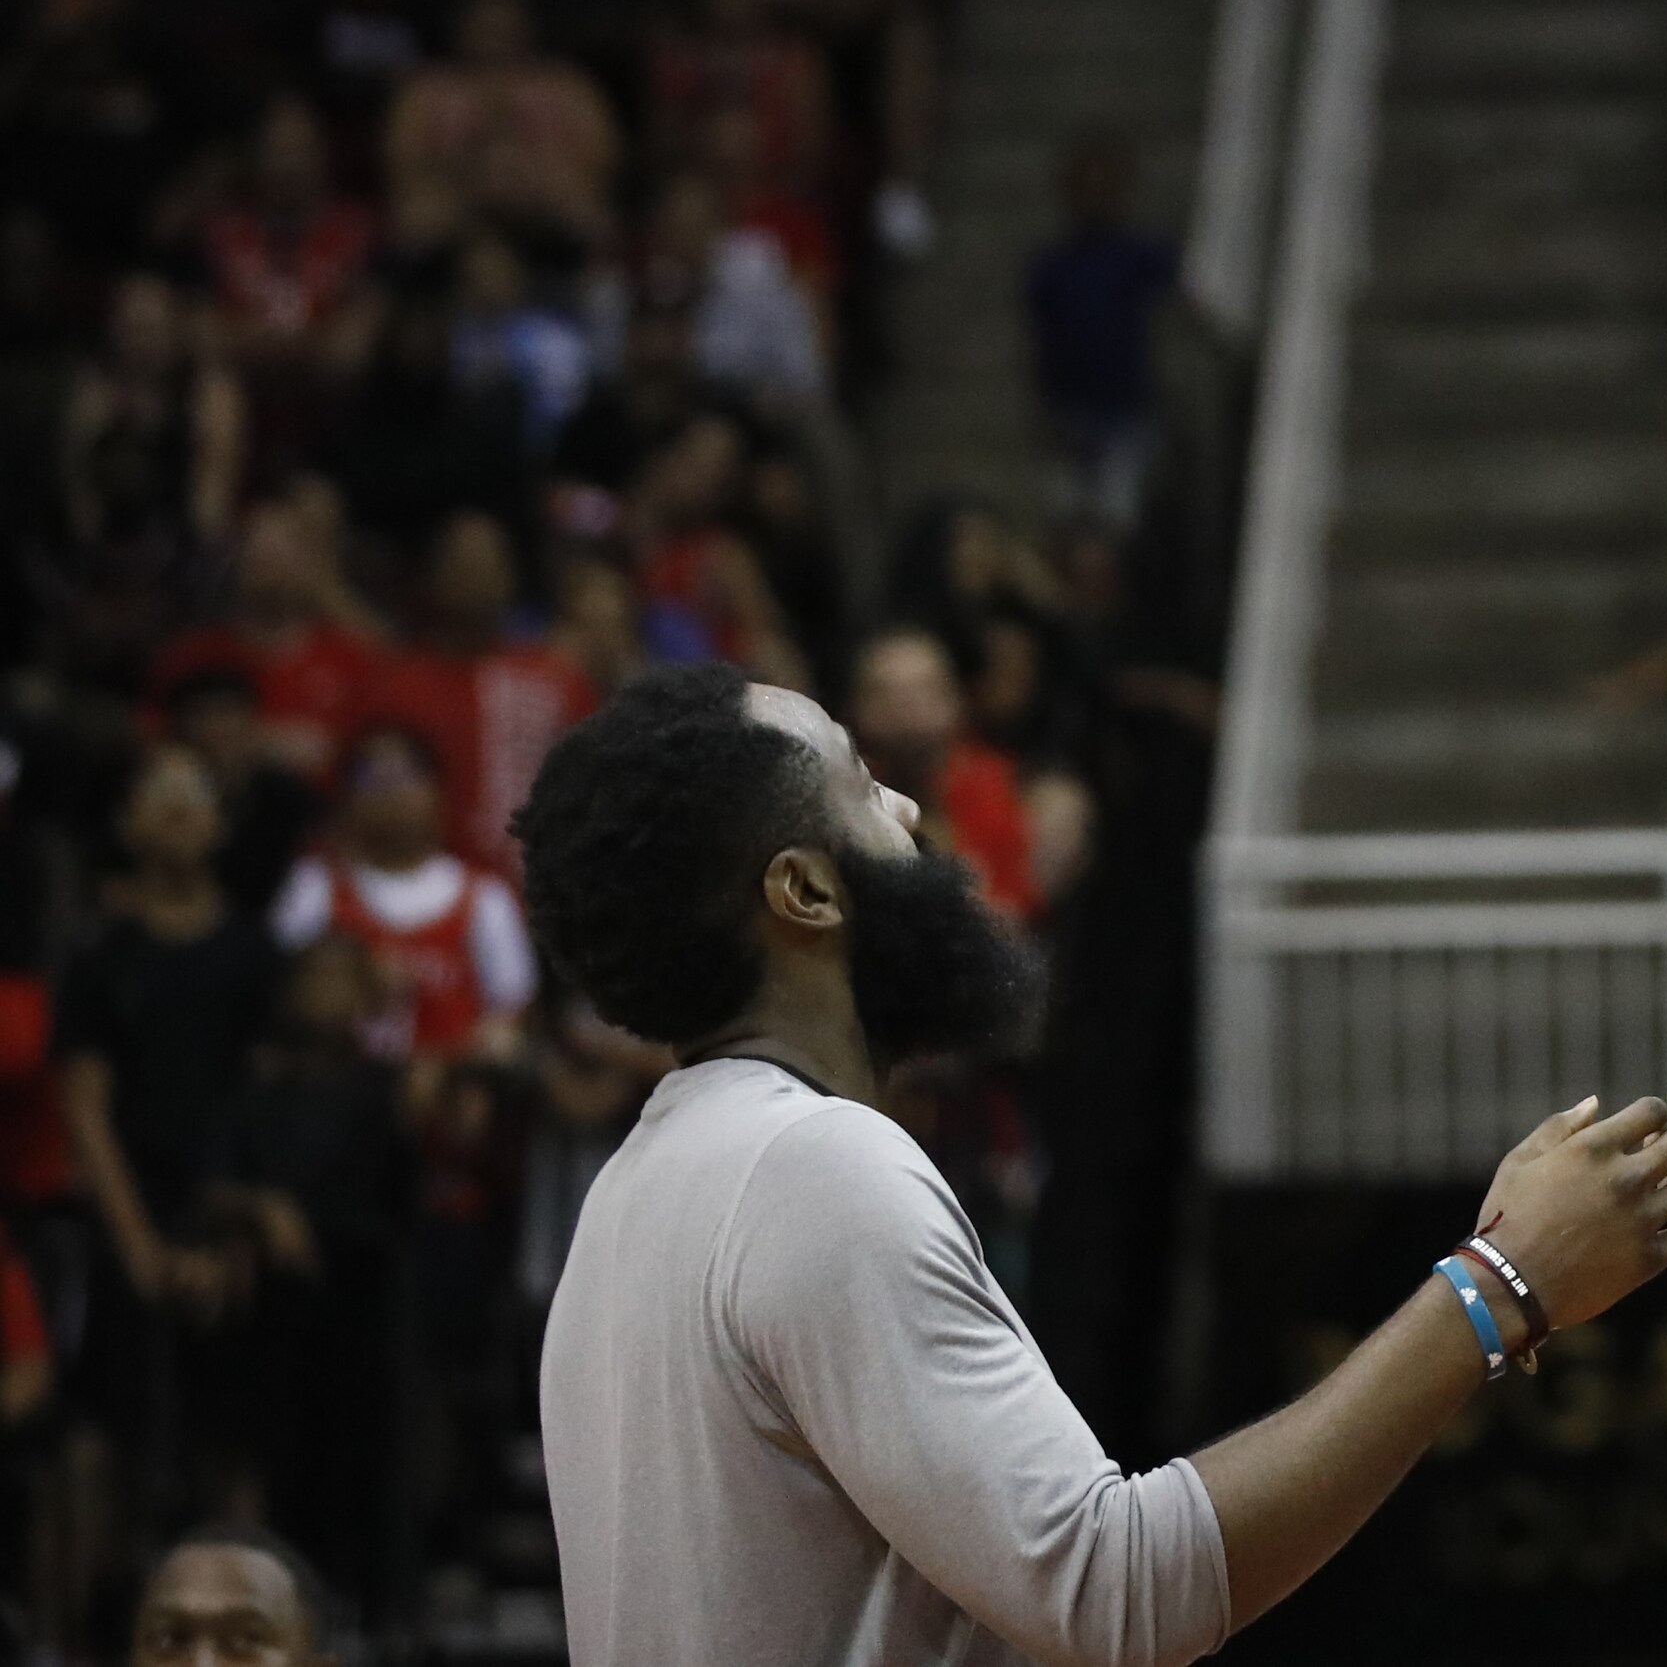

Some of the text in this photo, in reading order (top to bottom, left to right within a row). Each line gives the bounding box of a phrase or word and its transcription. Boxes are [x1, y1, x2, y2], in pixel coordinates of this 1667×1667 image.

[1469, 1237, 1529, 1297] HIT UR SWITCH
